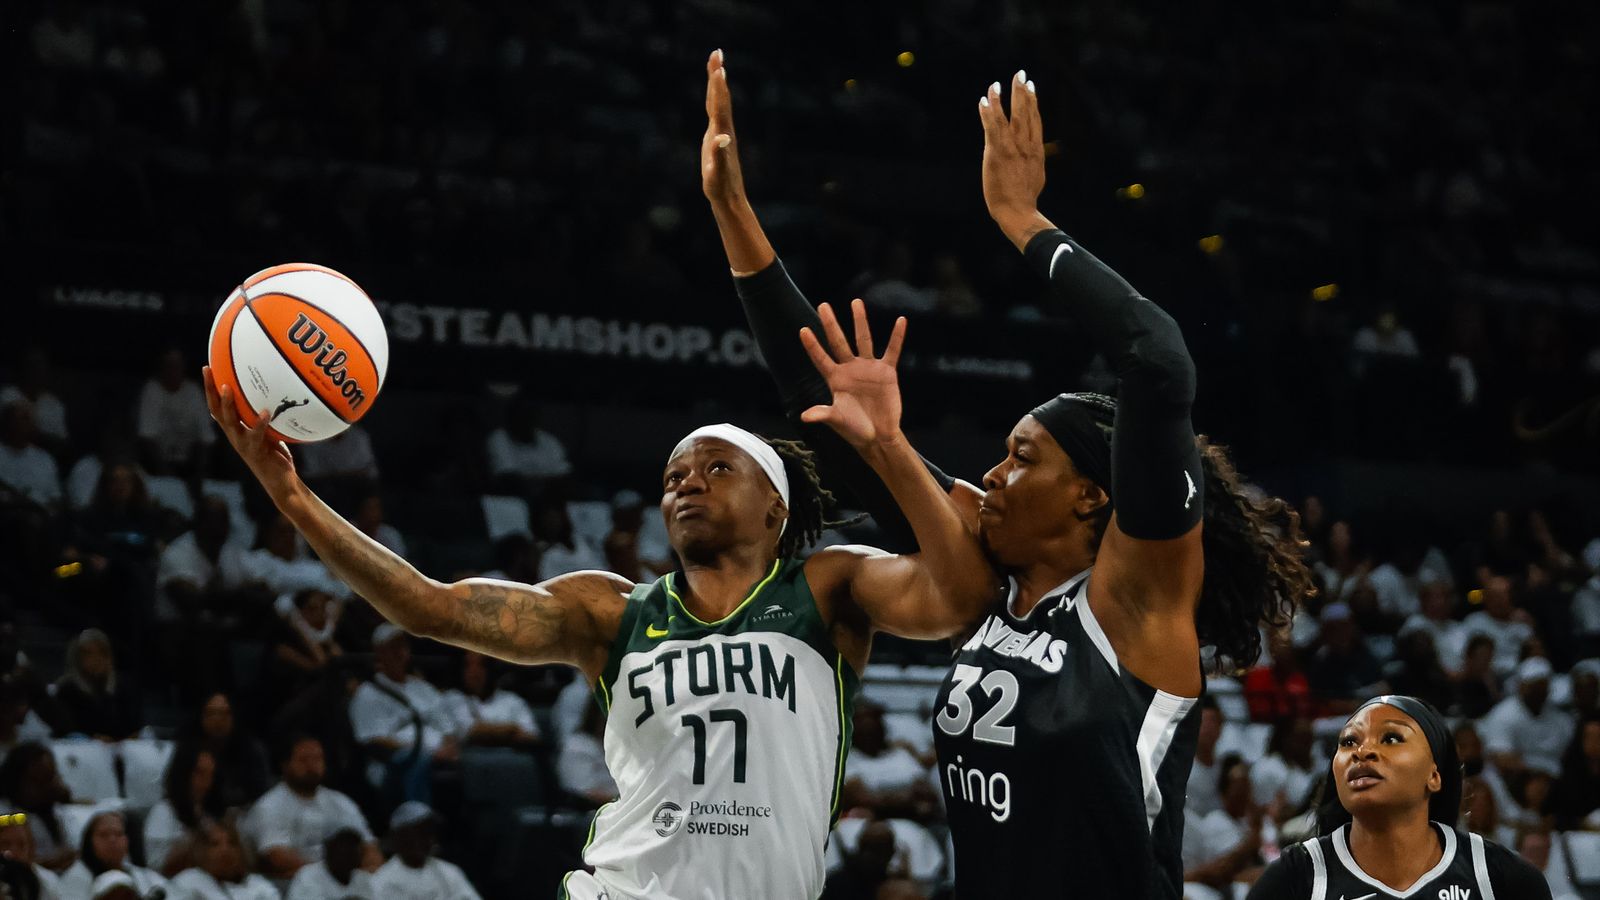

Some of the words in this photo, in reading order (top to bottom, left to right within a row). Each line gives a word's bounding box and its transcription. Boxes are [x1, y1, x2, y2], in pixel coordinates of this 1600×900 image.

[286, 311, 366, 411] Wilson
[374, 302, 766, 368] STEAMSHOP.C
[628, 642, 797, 729] STORM
[936, 664, 1019, 746] 32
[681, 709, 748, 785] 17
[690, 800, 771, 818] Providence
[947, 755, 1011, 822] ring
[687, 821, 749, 837] SWEDISH
[1438, 885, 1471, 900] ally
